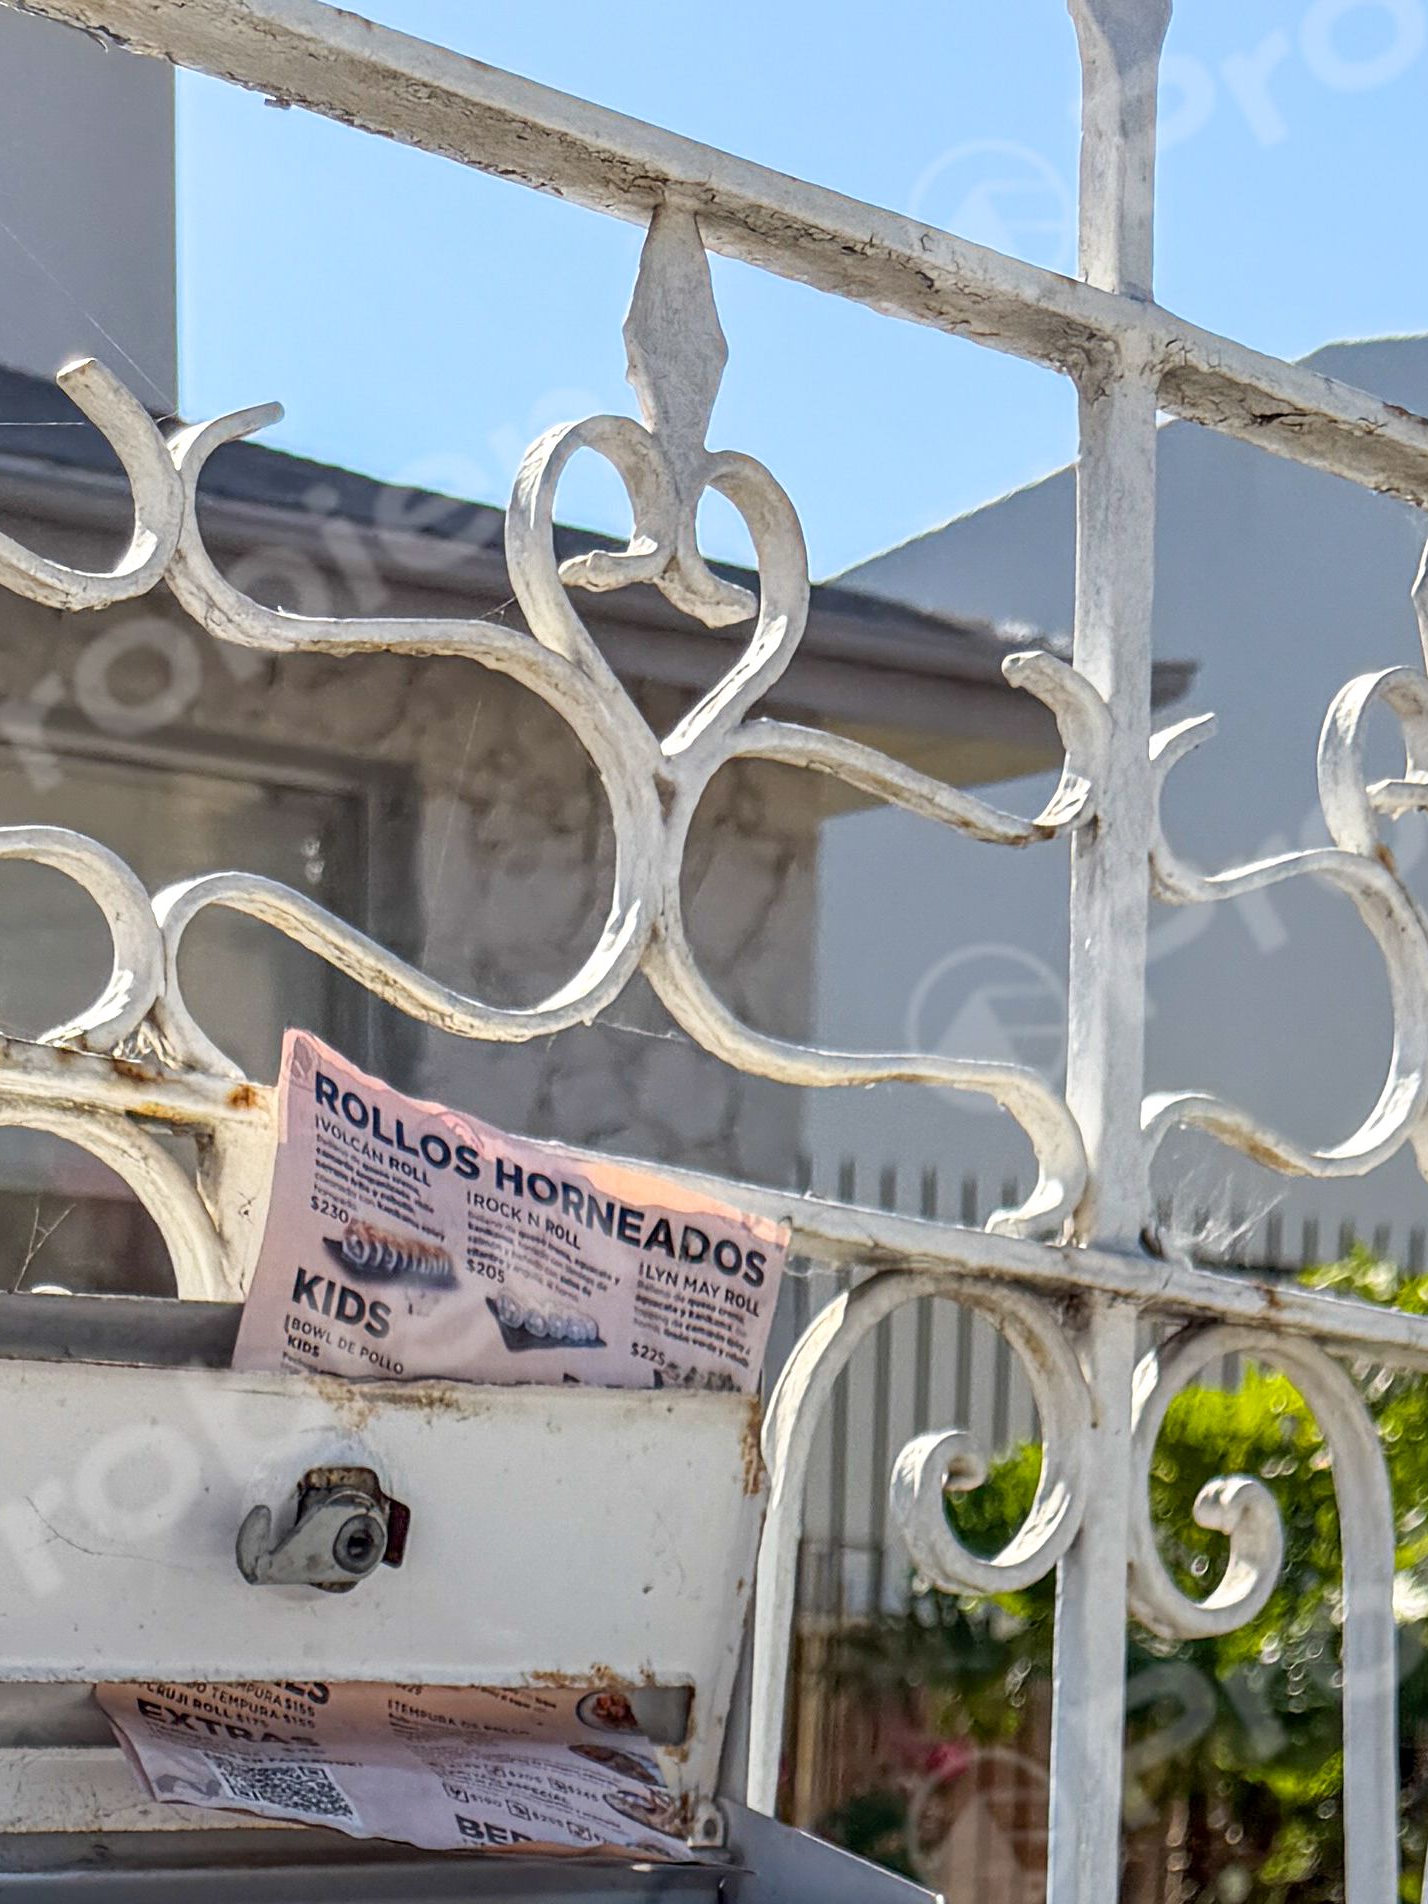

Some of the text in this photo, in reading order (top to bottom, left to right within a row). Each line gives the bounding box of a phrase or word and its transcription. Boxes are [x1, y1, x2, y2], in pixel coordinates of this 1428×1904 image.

[315, 1071, 481, 1181] ROLLOS
[495, 1157, 767, 1288] HORNEADOS
[388, 1156, 431, 1188] ROLL
[310, 1195, 350, 1225] $230
[473, 1192, 581, 1251] ROCK N ROLL
[291, 1266, 392, 1339] KIDS
[645, 1264, 760, 1318] LYN MAY ROLL
[287, 1334, 321, 1358] KIDS
[291, 1317, 404, 1375] BOWL DE POLLO
